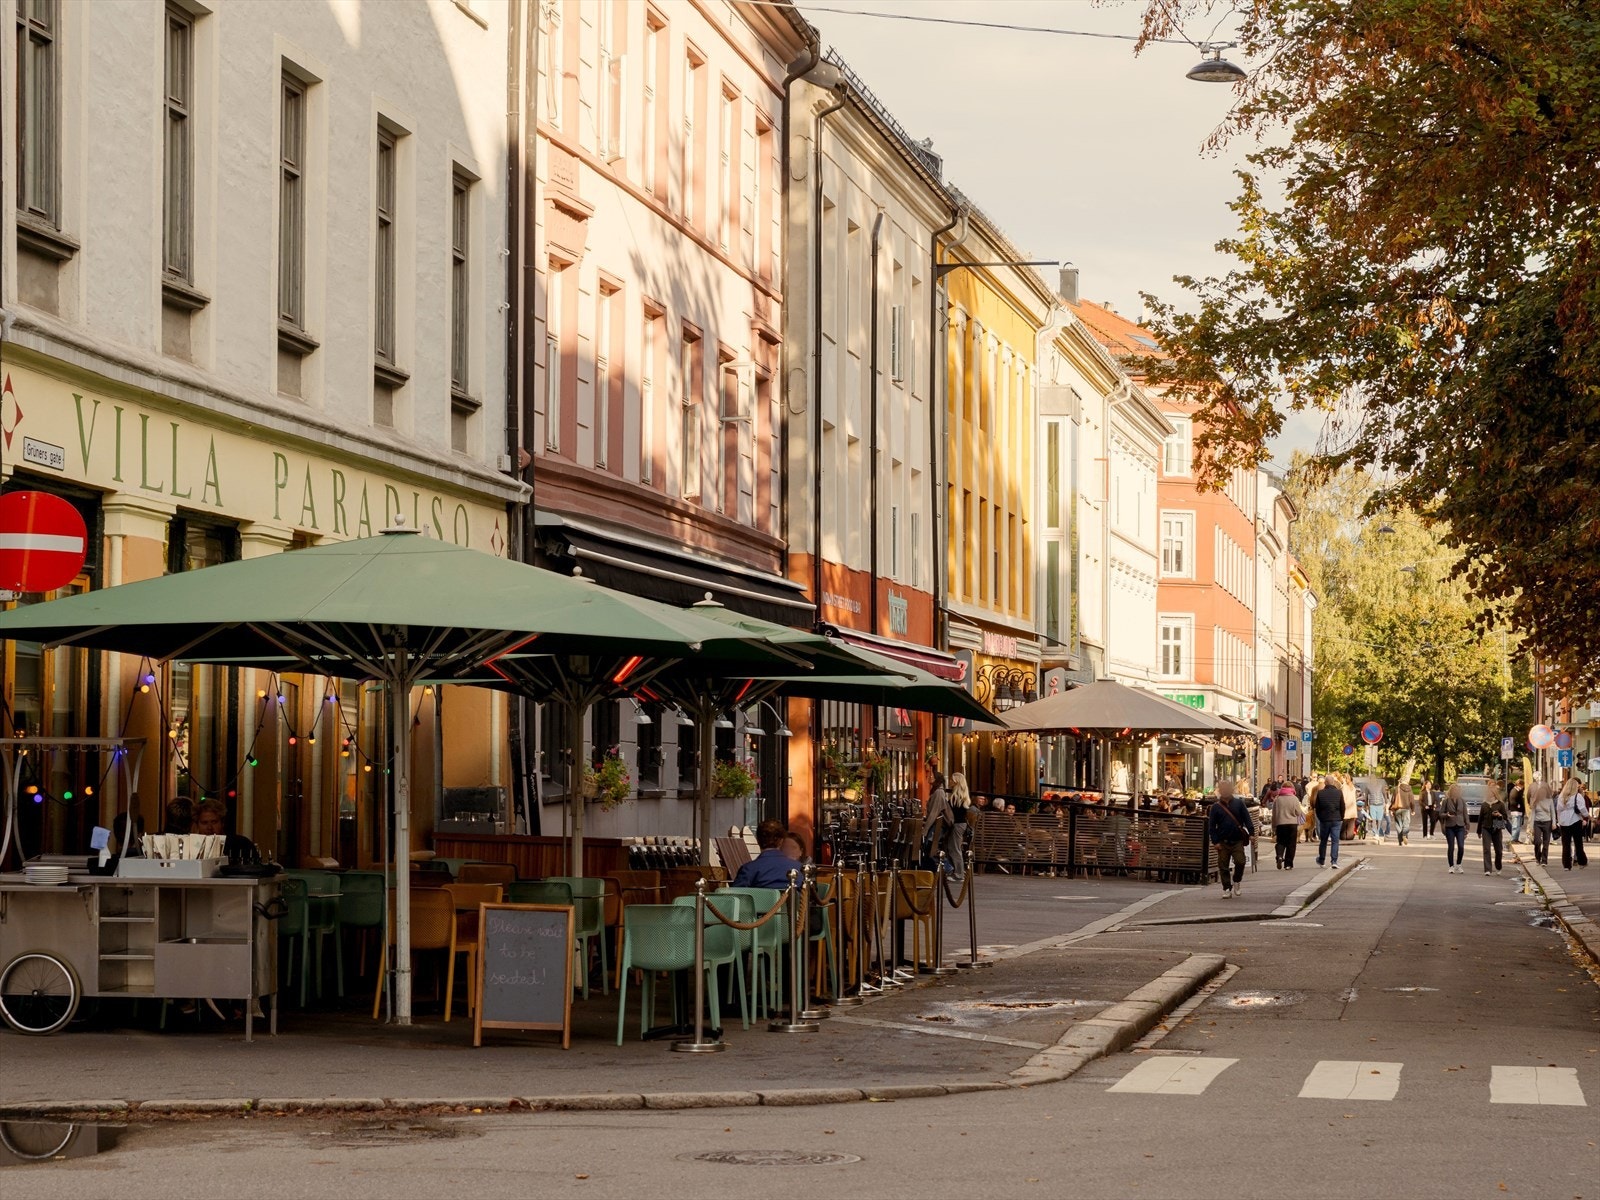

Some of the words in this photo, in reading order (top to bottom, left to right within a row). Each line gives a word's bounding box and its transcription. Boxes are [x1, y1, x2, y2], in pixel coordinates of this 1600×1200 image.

[27, 443, 47, 460] Grüners
[50, 452, 61, 465] gate
[72, 393, 224, 507] VILLA
[273, 451, 469, 548] PARADISO
[1304, 732, 1309, 740] P
[1504, 739, 1511, 749] P
[1288, 741, 1295, 749] P
[489, 917, 533, 934] Please
[499, 943, 518, 958] to
[489, 968, 546, 985] seated!
